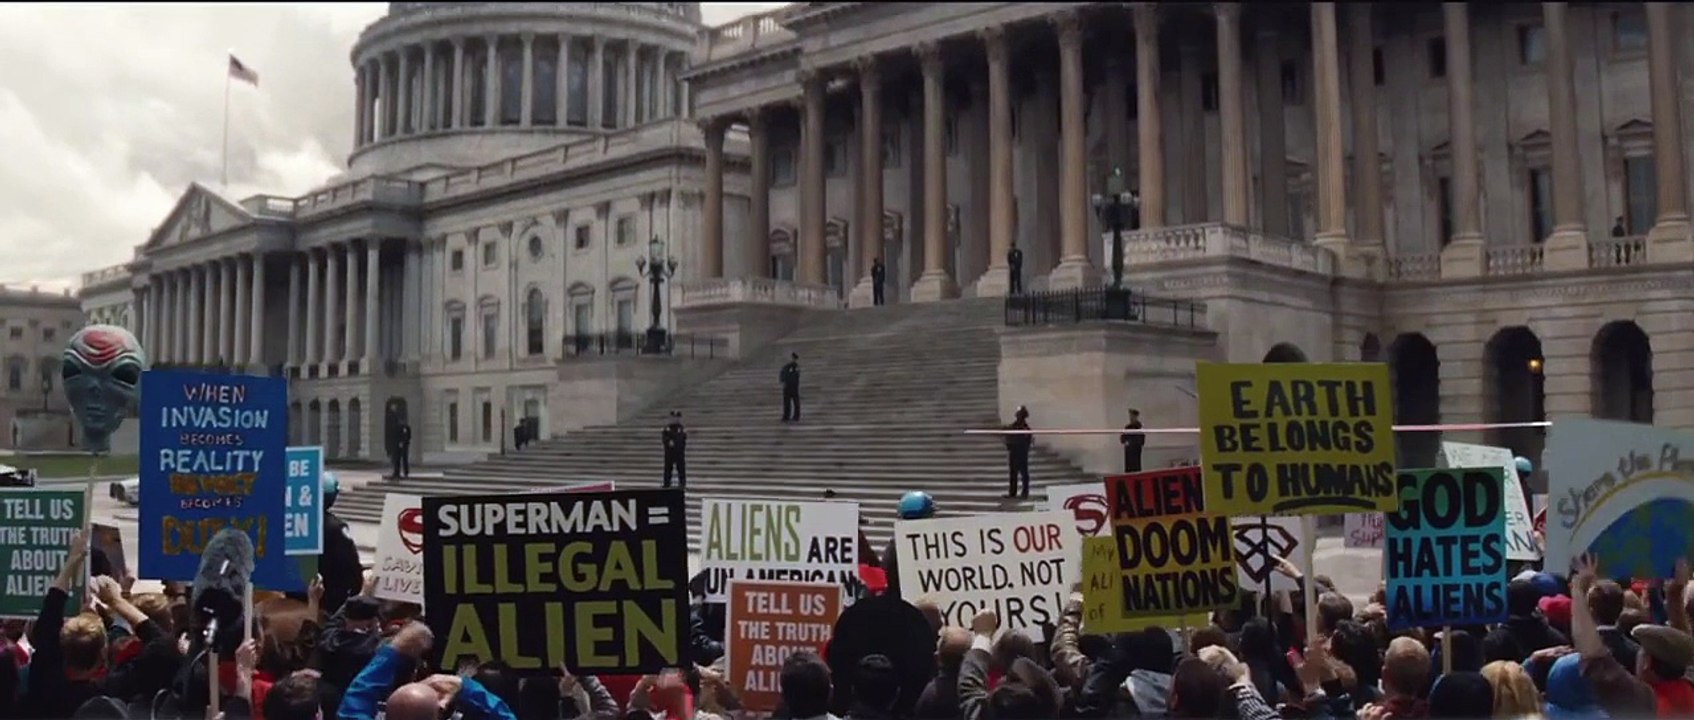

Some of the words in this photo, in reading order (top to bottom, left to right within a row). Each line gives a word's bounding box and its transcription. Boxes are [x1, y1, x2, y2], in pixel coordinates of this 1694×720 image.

[183, 383, 246, 404] WHEN
[1230, 380, 1376, 419] EARTH
[161, 406, 269, 429] INVASION
[1213, 420, 1374, 453] BELONGS
[180, 434, 244, 446] BECOMES
[160, 449, 264, 473] REALITY
[289, 460, 310, 476] BE
[1115, 472, 1204, 520] ALIEN
[1212, 462, 1269, 502] TO
[1276, 461, 1394, 498] HUMANS
[4, 498, 45, 520] TELL
[50, 498, 74, 520] US
[438, 498, 637, 537] SUPERMAN
[1388, 472, 1501, 531] GOD
[0, 527, 27, 545] THE
[706, 503, 801, 562] ALIENS
[807, 536, 853, 564] ARE
[906, 531, 968, 561] THIS
[980, 528, 1005, 555] IS
[1013, 523, 1063, 553] OUR
[1116, 517, 1231, 569] DOOM
[443, 539, 675, 595] ILLEGAL
[1388, 533, 1504, 578] HATES
[6, 574, 74, 597] ALIEN!
[918, 564, 1014, 593] WORLD.
[1020, 558, 1065, 587] NOT
[1121, 567, 1237, 612] NATIONS
[745, 591, 794, 615] TELL
[799, 593, 826, 616] US
[1391, 581, 1505, 621] ALIENS
[440, 599, 679, 671] ALIEN
[738, 620, 770, 641] THE
[775, 621, 832, 642] TRUTH
